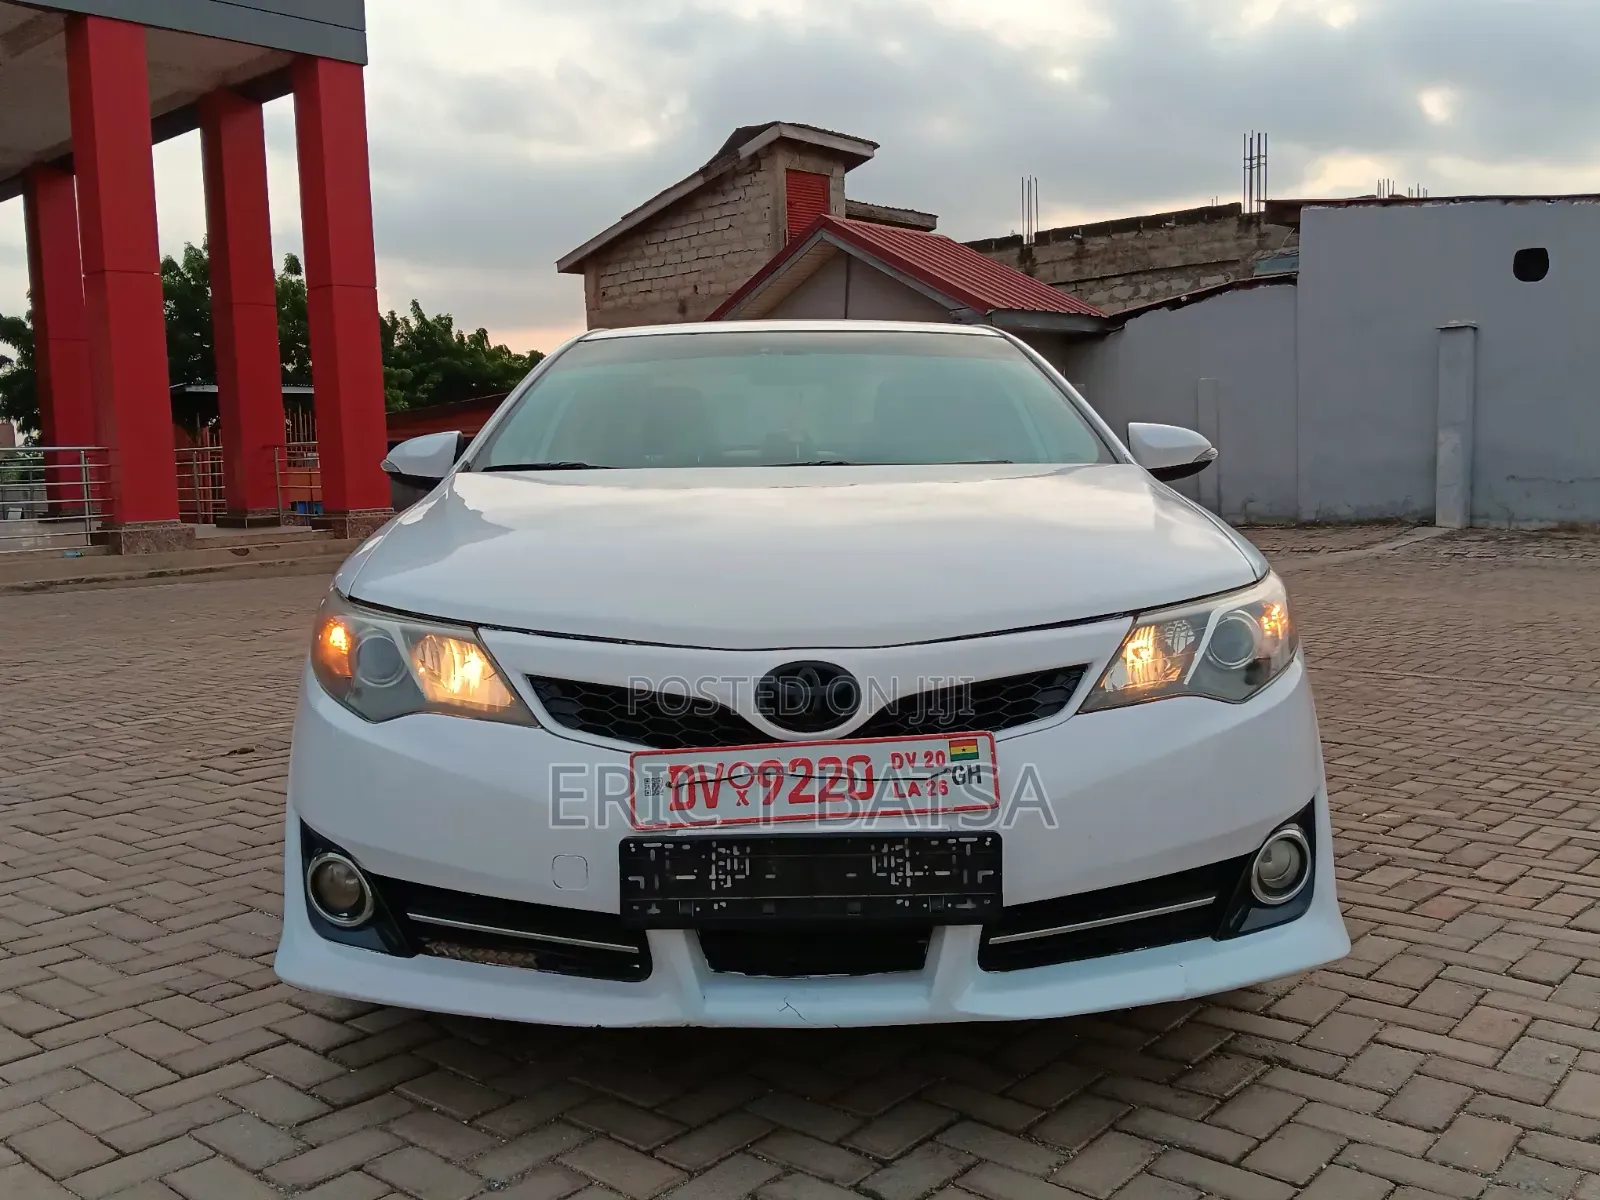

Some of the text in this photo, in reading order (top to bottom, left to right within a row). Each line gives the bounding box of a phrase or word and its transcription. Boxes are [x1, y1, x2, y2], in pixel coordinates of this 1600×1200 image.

[890, 749, 946, 769] DV 20
[668, 762, 724, 811] DV
[757, 754, 875, 807] 9220
[951, 764, 982, 785] GH
[893, 781, 922, 798] LA
